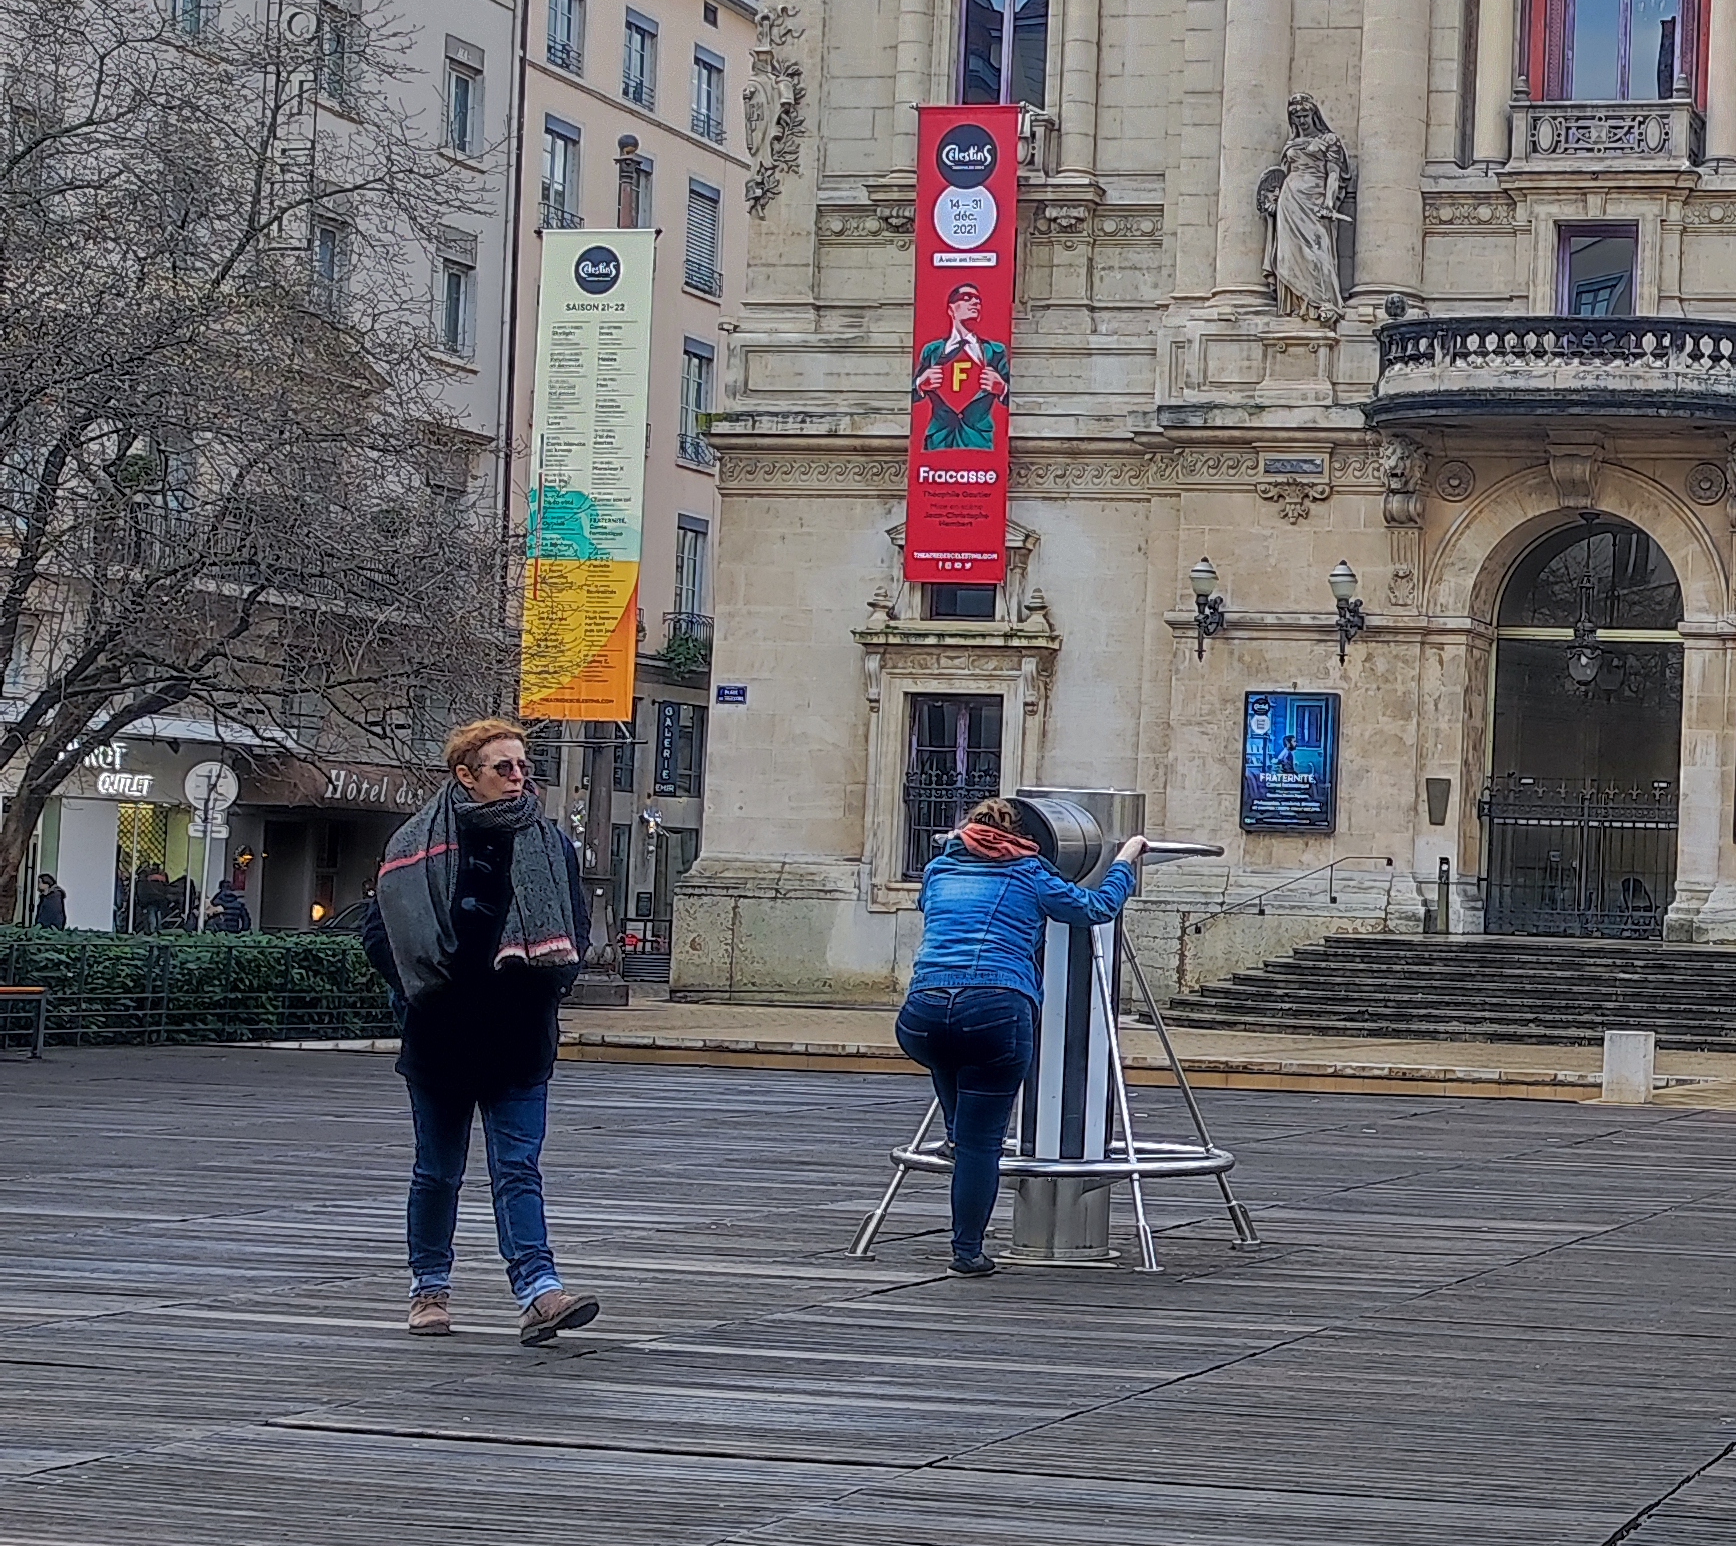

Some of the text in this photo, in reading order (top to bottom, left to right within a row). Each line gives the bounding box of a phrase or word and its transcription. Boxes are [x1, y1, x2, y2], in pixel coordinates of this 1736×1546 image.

[953, 223, 977, 235] 2021
[565, 303, 599, 311] SAISON
[953, 361, 972, 391] F
[919, 466, 997, 484] Fracasse
[662, 706, 674, 780] GALERIE
[324, 769, 388, 803] Hôtel
